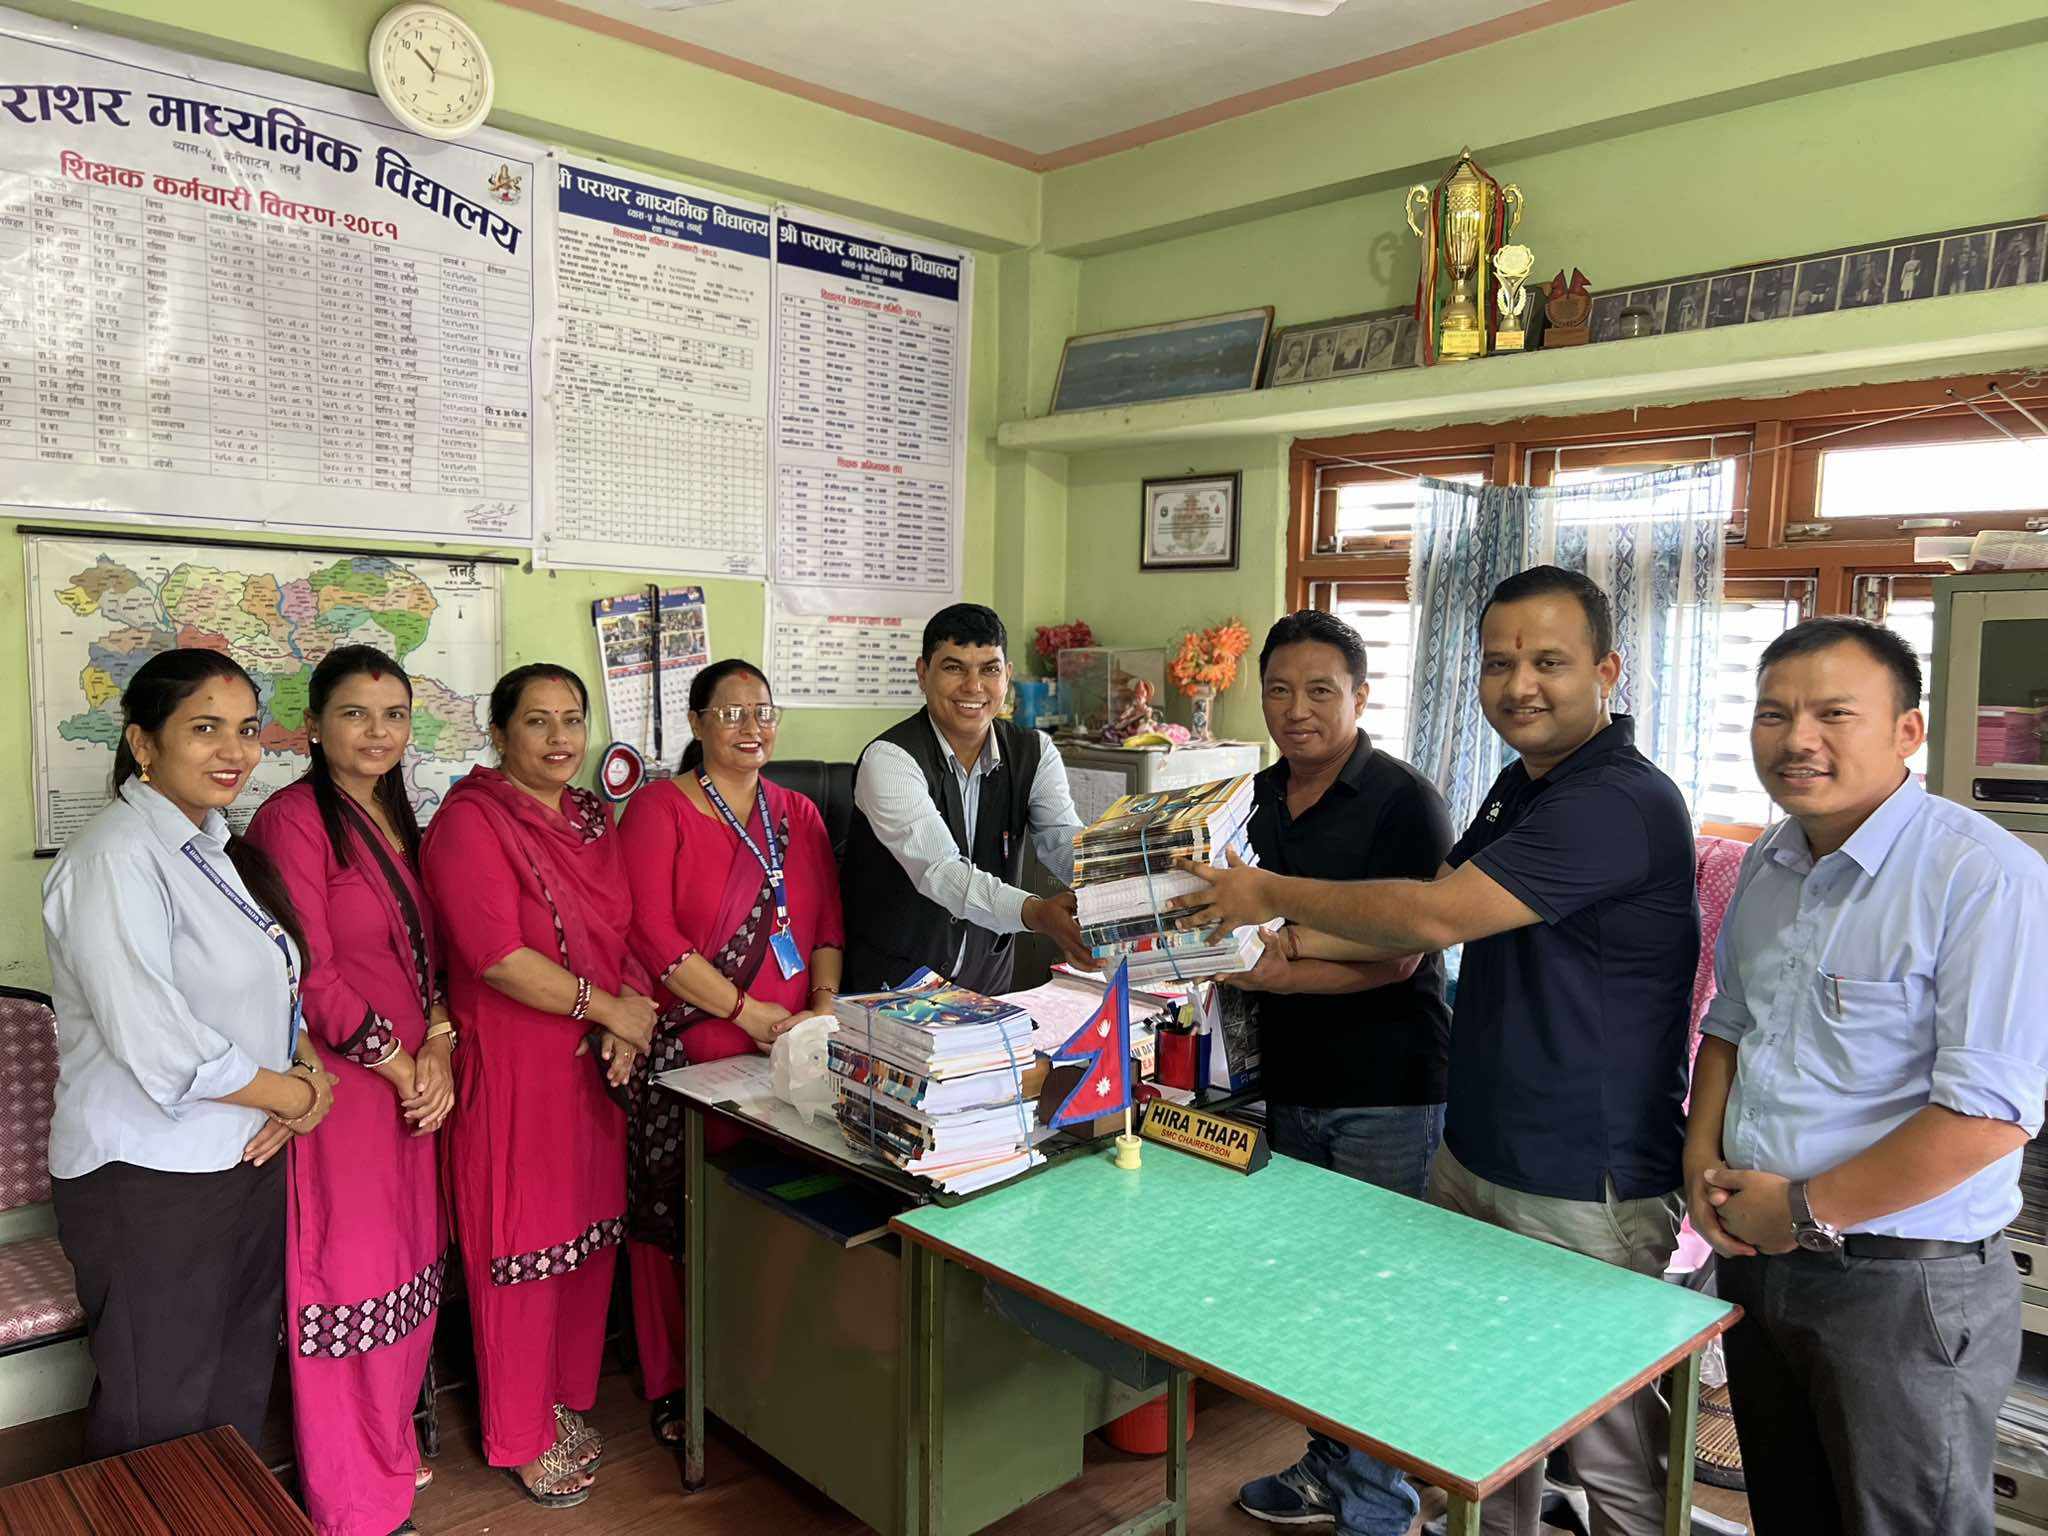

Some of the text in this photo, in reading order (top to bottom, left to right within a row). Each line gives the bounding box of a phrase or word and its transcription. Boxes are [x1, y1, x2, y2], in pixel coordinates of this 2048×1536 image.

[402, 40, 411, 50] 10
[462, 58, 467, 67] 2
[412, 93, 418, 102] 7
[446, 104, 452, 112] 5
[0, 84, 523, 255] राशर माध्यमिक विद्यालय
[59, 150, 399, 241] शिक्षक कर्मचारी विवरण-२०८१
[577, 176, 632, 204] पराशर
[635, 191, 708, 221] माध्यमिक
[713, 205, 769, 237] विद्यालय
[780, 224, 957, 281] श्री पराशर माध्यमिक विद्यालय
[1151, 1105, 1249, 1152] HIRA THAPA
[1161, 1128, 1231, 1159] SMC CHAIRPERSON
